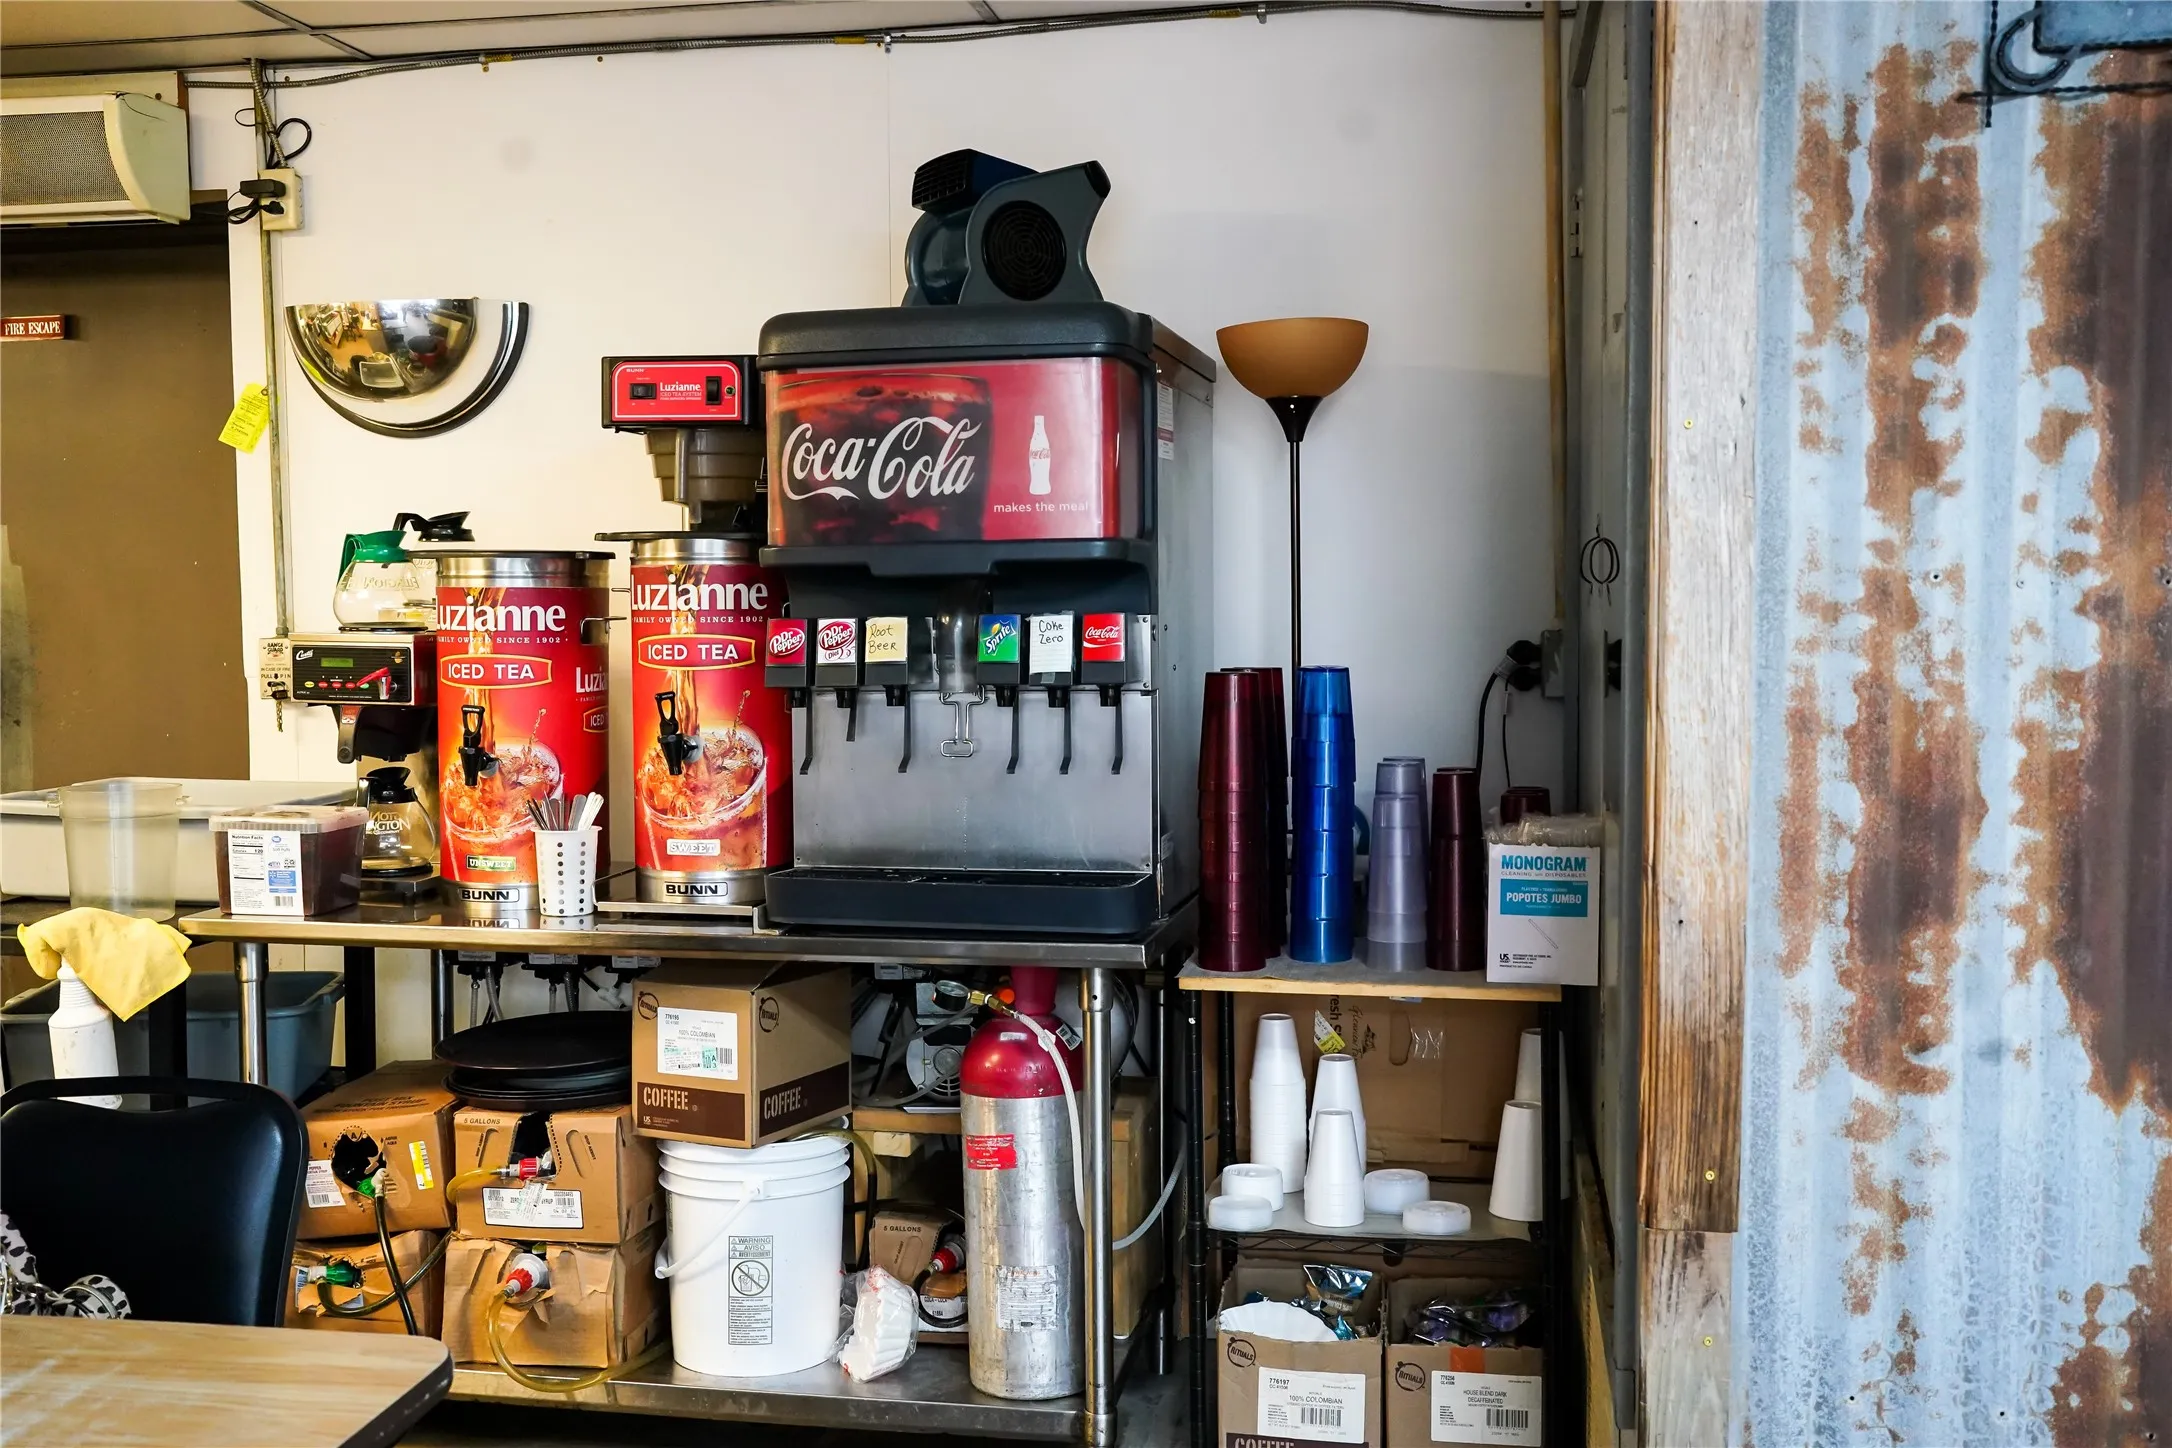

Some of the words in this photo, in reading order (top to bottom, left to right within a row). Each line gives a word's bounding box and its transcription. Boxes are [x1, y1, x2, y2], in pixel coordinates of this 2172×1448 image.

[5, 322, 25, 335] FIRE
[28, 321, 61, 334] ESCAPE
[660, 382, 701, 391] Luzianne
[782, 416, 983, 500] Coca-Cola
[993, 502, 1032, 513] makes
[1036, 501, 1055, 512] the
[1059, 501, 1089, 511] meal
[780, 630, 794, 642] Dr
[831, 624, 843, 635] Dr
[869, 624, 894, 637] Root
[1085, 625, 1121, 639] Coca-Cola
[770, 633, 803, 654] Pepper
[823, 628, 853, 647] Pepper
[985, 624, 1011, 654] Sprite
[1039, 634, 1064, 645] Zero
[648, 644, 688, 660] ICED
[697, 644, 739, 660] TEA
[448, 664, 485, 679] ICED
[494, 664, 535, 679] TEA
[590, 714, 605, 727] ICED
[669, 841, 716, 852] SWEET
[469, 857, 512, 868] UNSWEET
[1501, 855, 1587, 872] MONOGRAM
[461, 889, 510, 900] BUNN
[666, 884, 720, 895] BUNN
[1506, 892, 1548, 903] POPOTES
[1550, 893, 1582, 904] JUMBO
[1330, 994, 1342, 1020] resh
[690, 1030, 716, 1038] COLOMBIAN
[643, 1086, 689, 1110] COFFEE
[764, 1086, 802, 1120] COFFEE
[350, 1132, 357, 1140] A
[1230, 1346, 1254, 1361] RITUALS
[1398, 1370, 1423, 1384] RITUALS
[1305, 1396, 1343, 1404] COLOMBIAN
